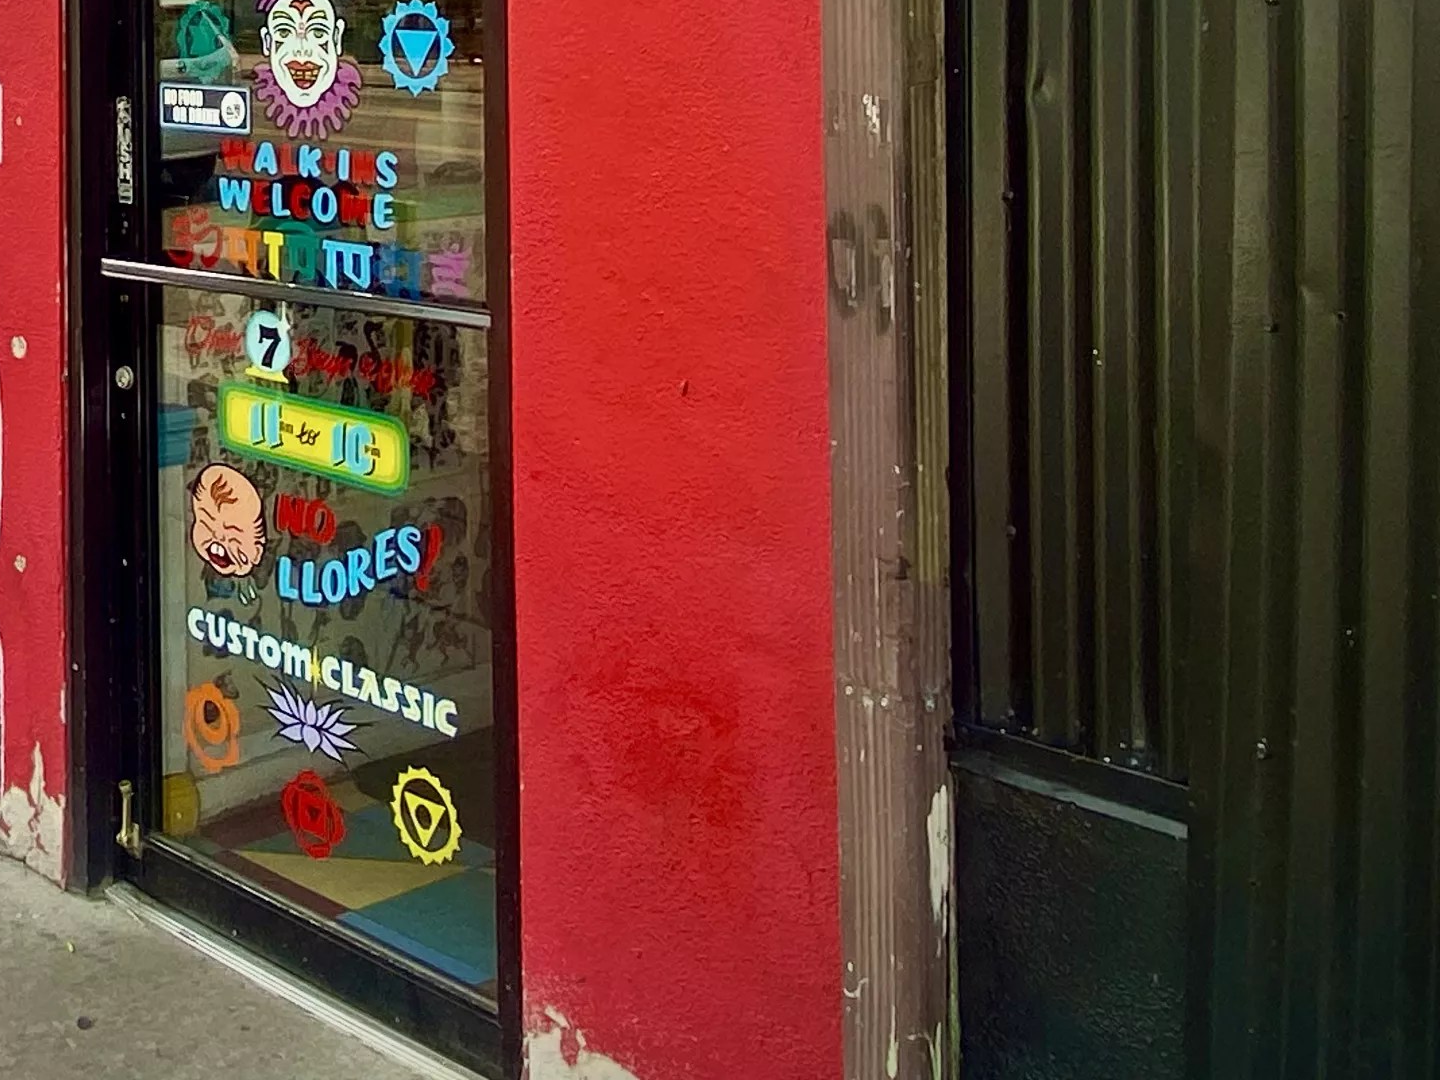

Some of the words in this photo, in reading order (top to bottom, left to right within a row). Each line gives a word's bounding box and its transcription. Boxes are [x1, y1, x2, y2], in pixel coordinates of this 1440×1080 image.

[218, 176, 396, 230] WELCOME
[258, 323, 282, 369] 7
[296, 421, 321, 446] to
[276, 493, 337, 546] NO
[278, 523, 443, 604] LLORES!
[187, 607, 312, 683] CUSTOM
[320, 654, 458, 738] CLASSIC
